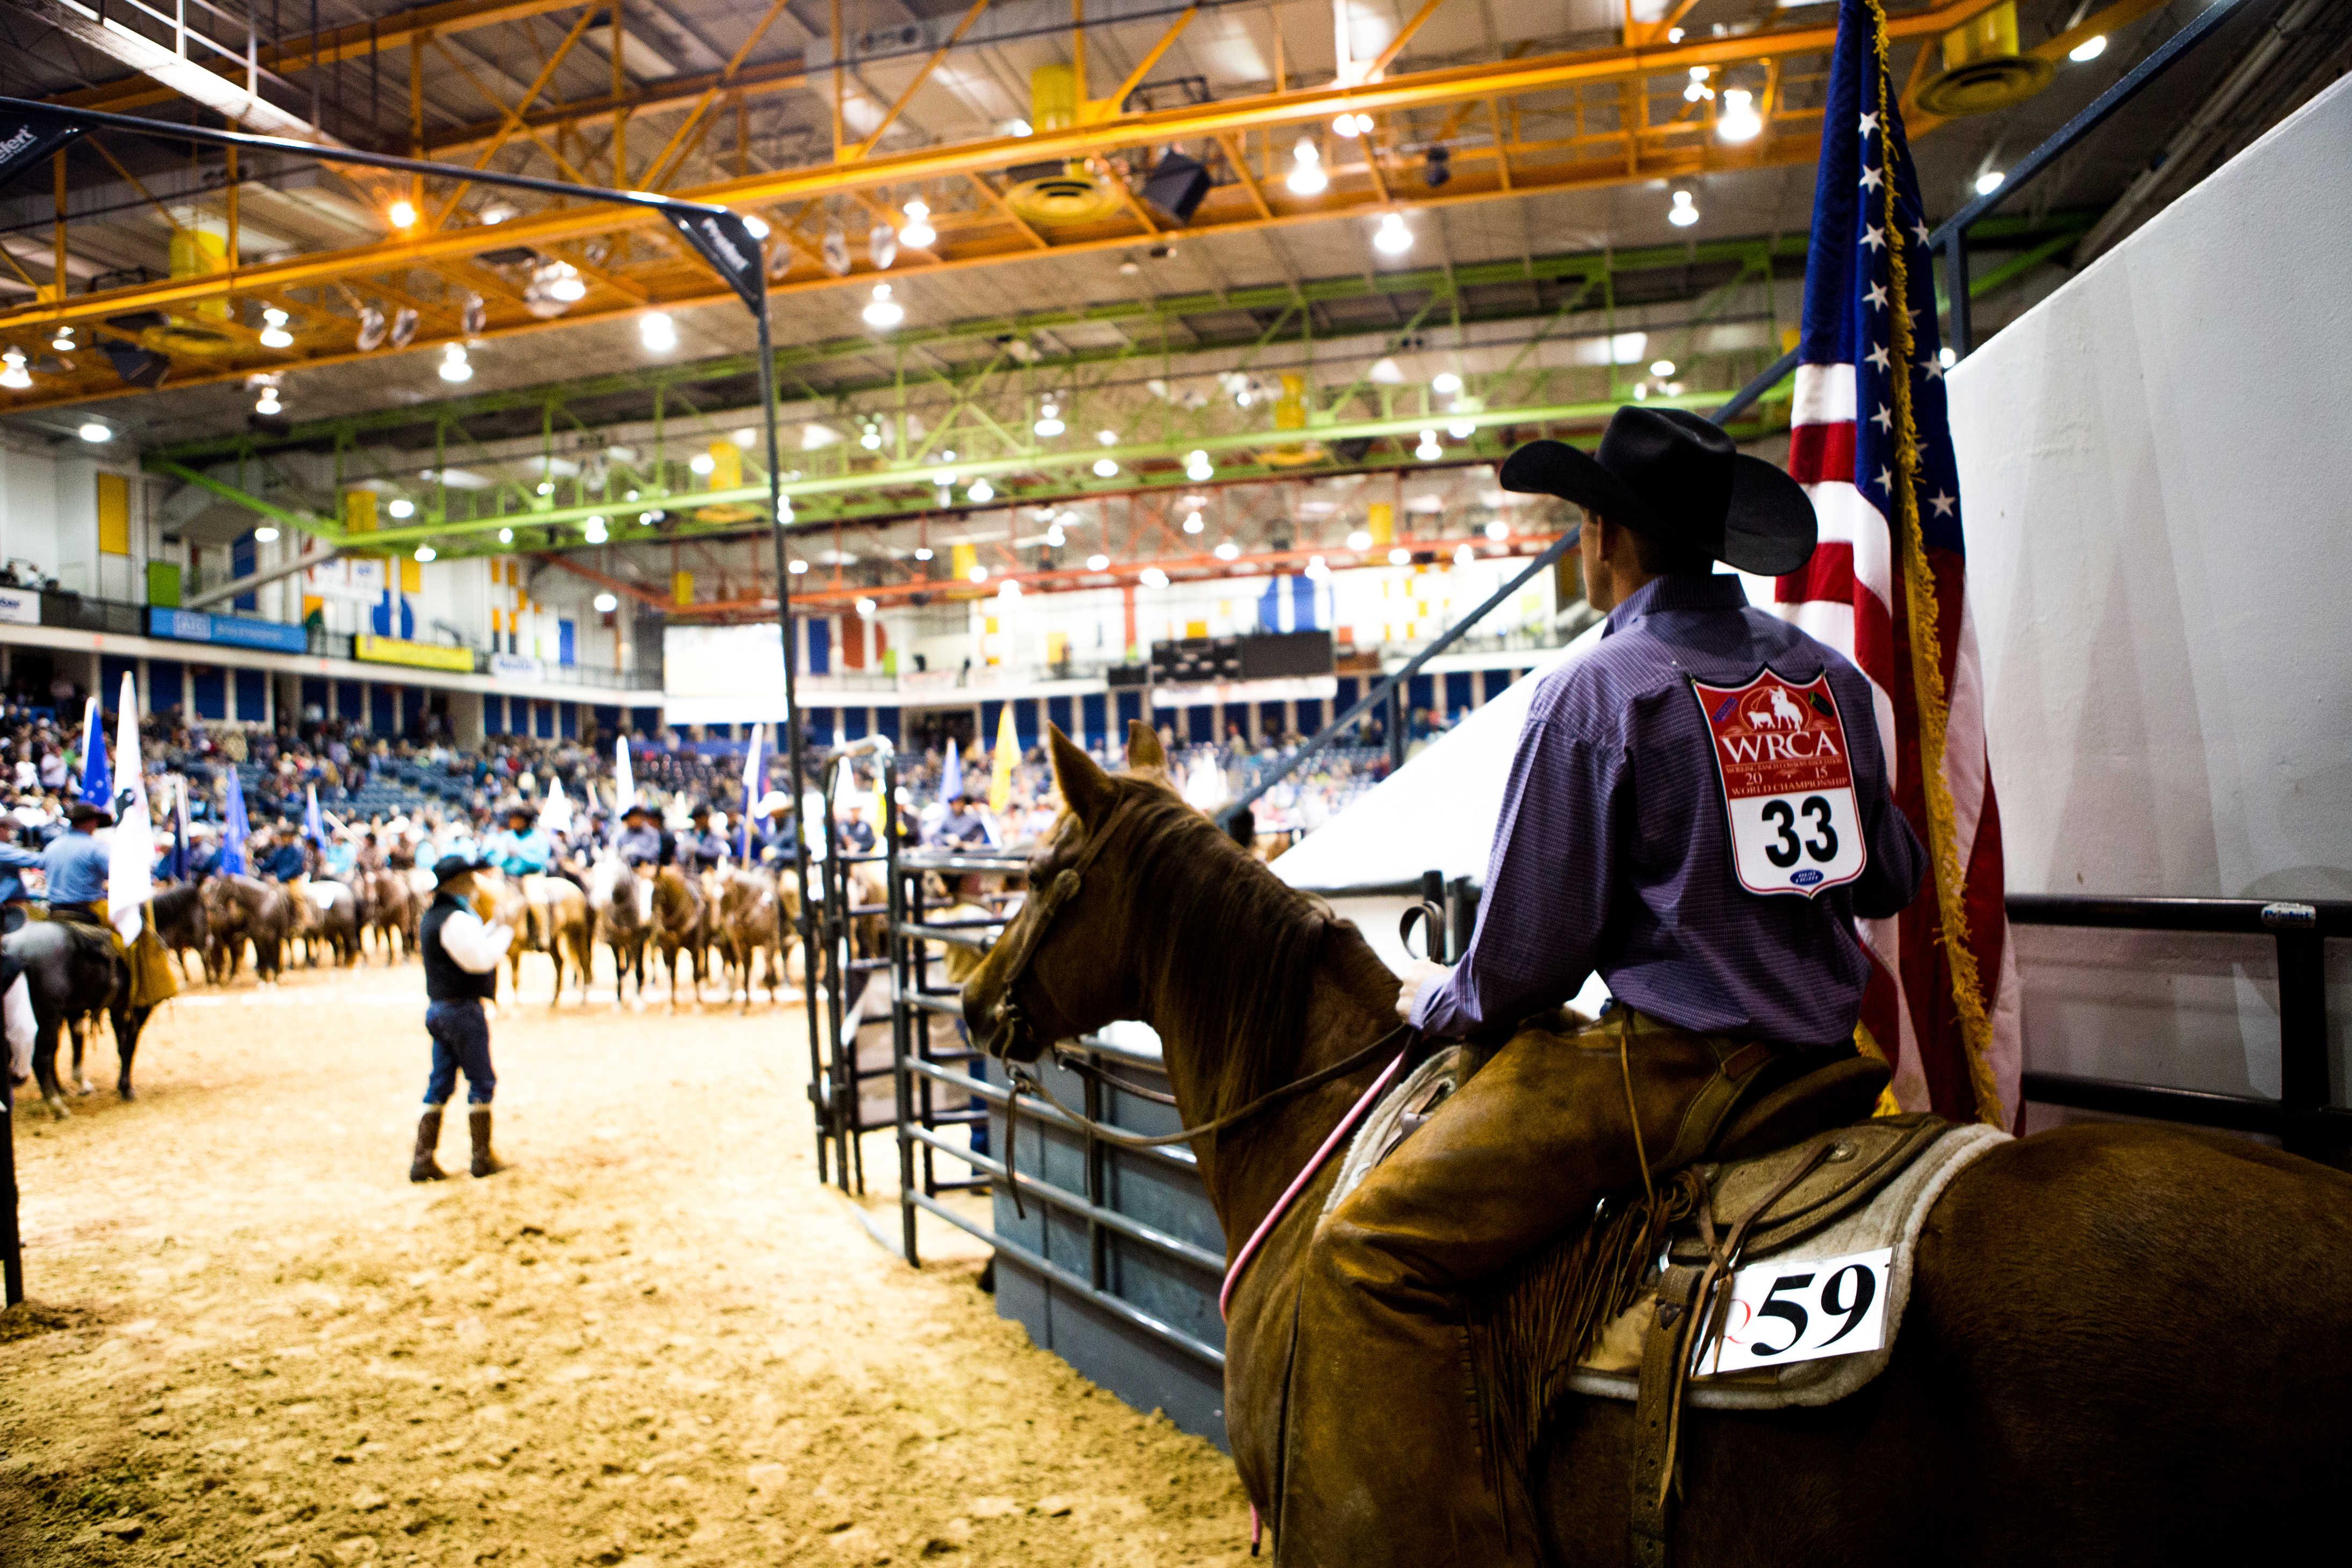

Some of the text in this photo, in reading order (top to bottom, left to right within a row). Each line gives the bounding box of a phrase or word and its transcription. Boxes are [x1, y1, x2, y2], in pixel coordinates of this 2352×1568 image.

[1721, 731, 1839, 763] WRCA
[1731, 777, 1848, 795] WORLD CHAMPIONSHIP
[1745, 765, 1828, 785] 20 15
[1762, 795, 1838, 868] 33
